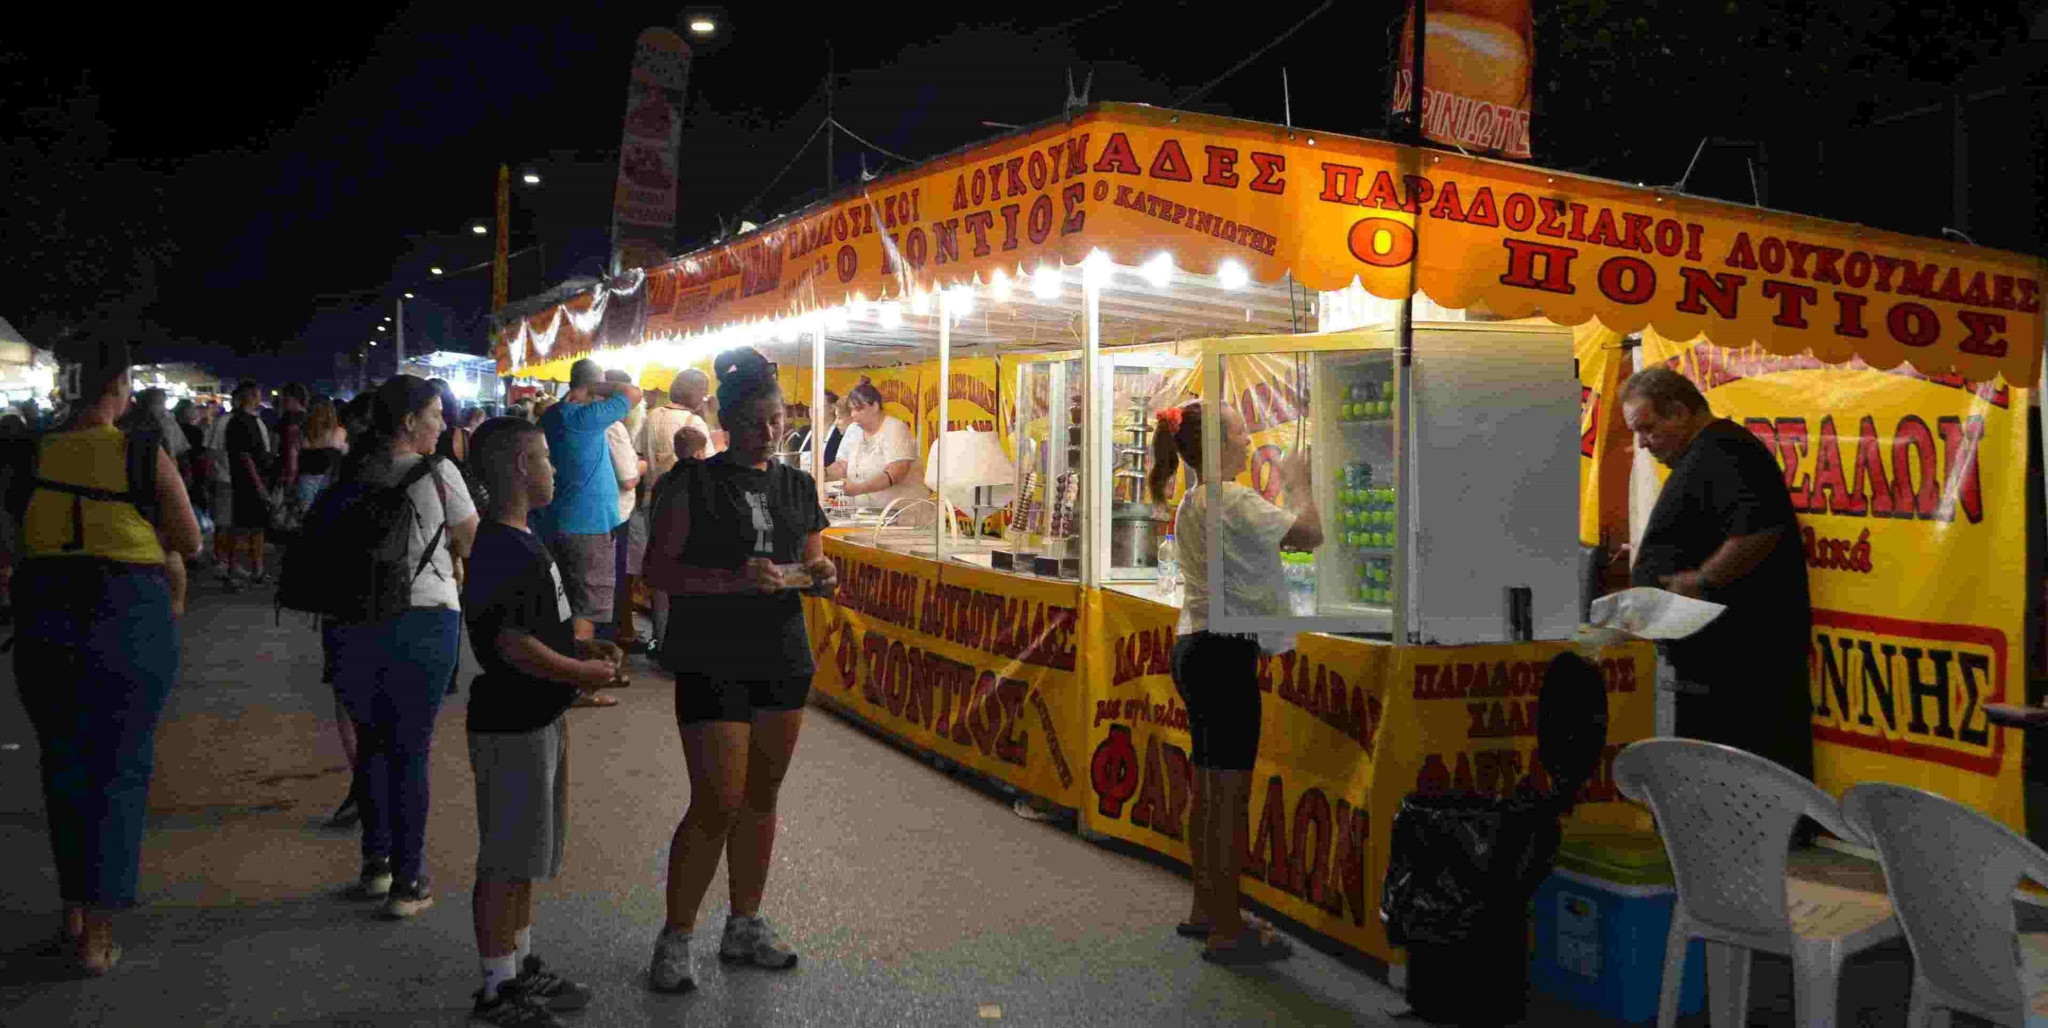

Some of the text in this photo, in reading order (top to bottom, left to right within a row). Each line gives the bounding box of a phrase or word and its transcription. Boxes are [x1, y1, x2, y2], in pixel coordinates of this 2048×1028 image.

[1320, 162, 2041, 314] ΠΑΡΑΔΟΣΙΑΚΟΙ ΛΟΥΚΟΥΜΑΔΕΣ
[1347, 216, 2009, 359] Ο ΠΟΝΤΙΟΣ
